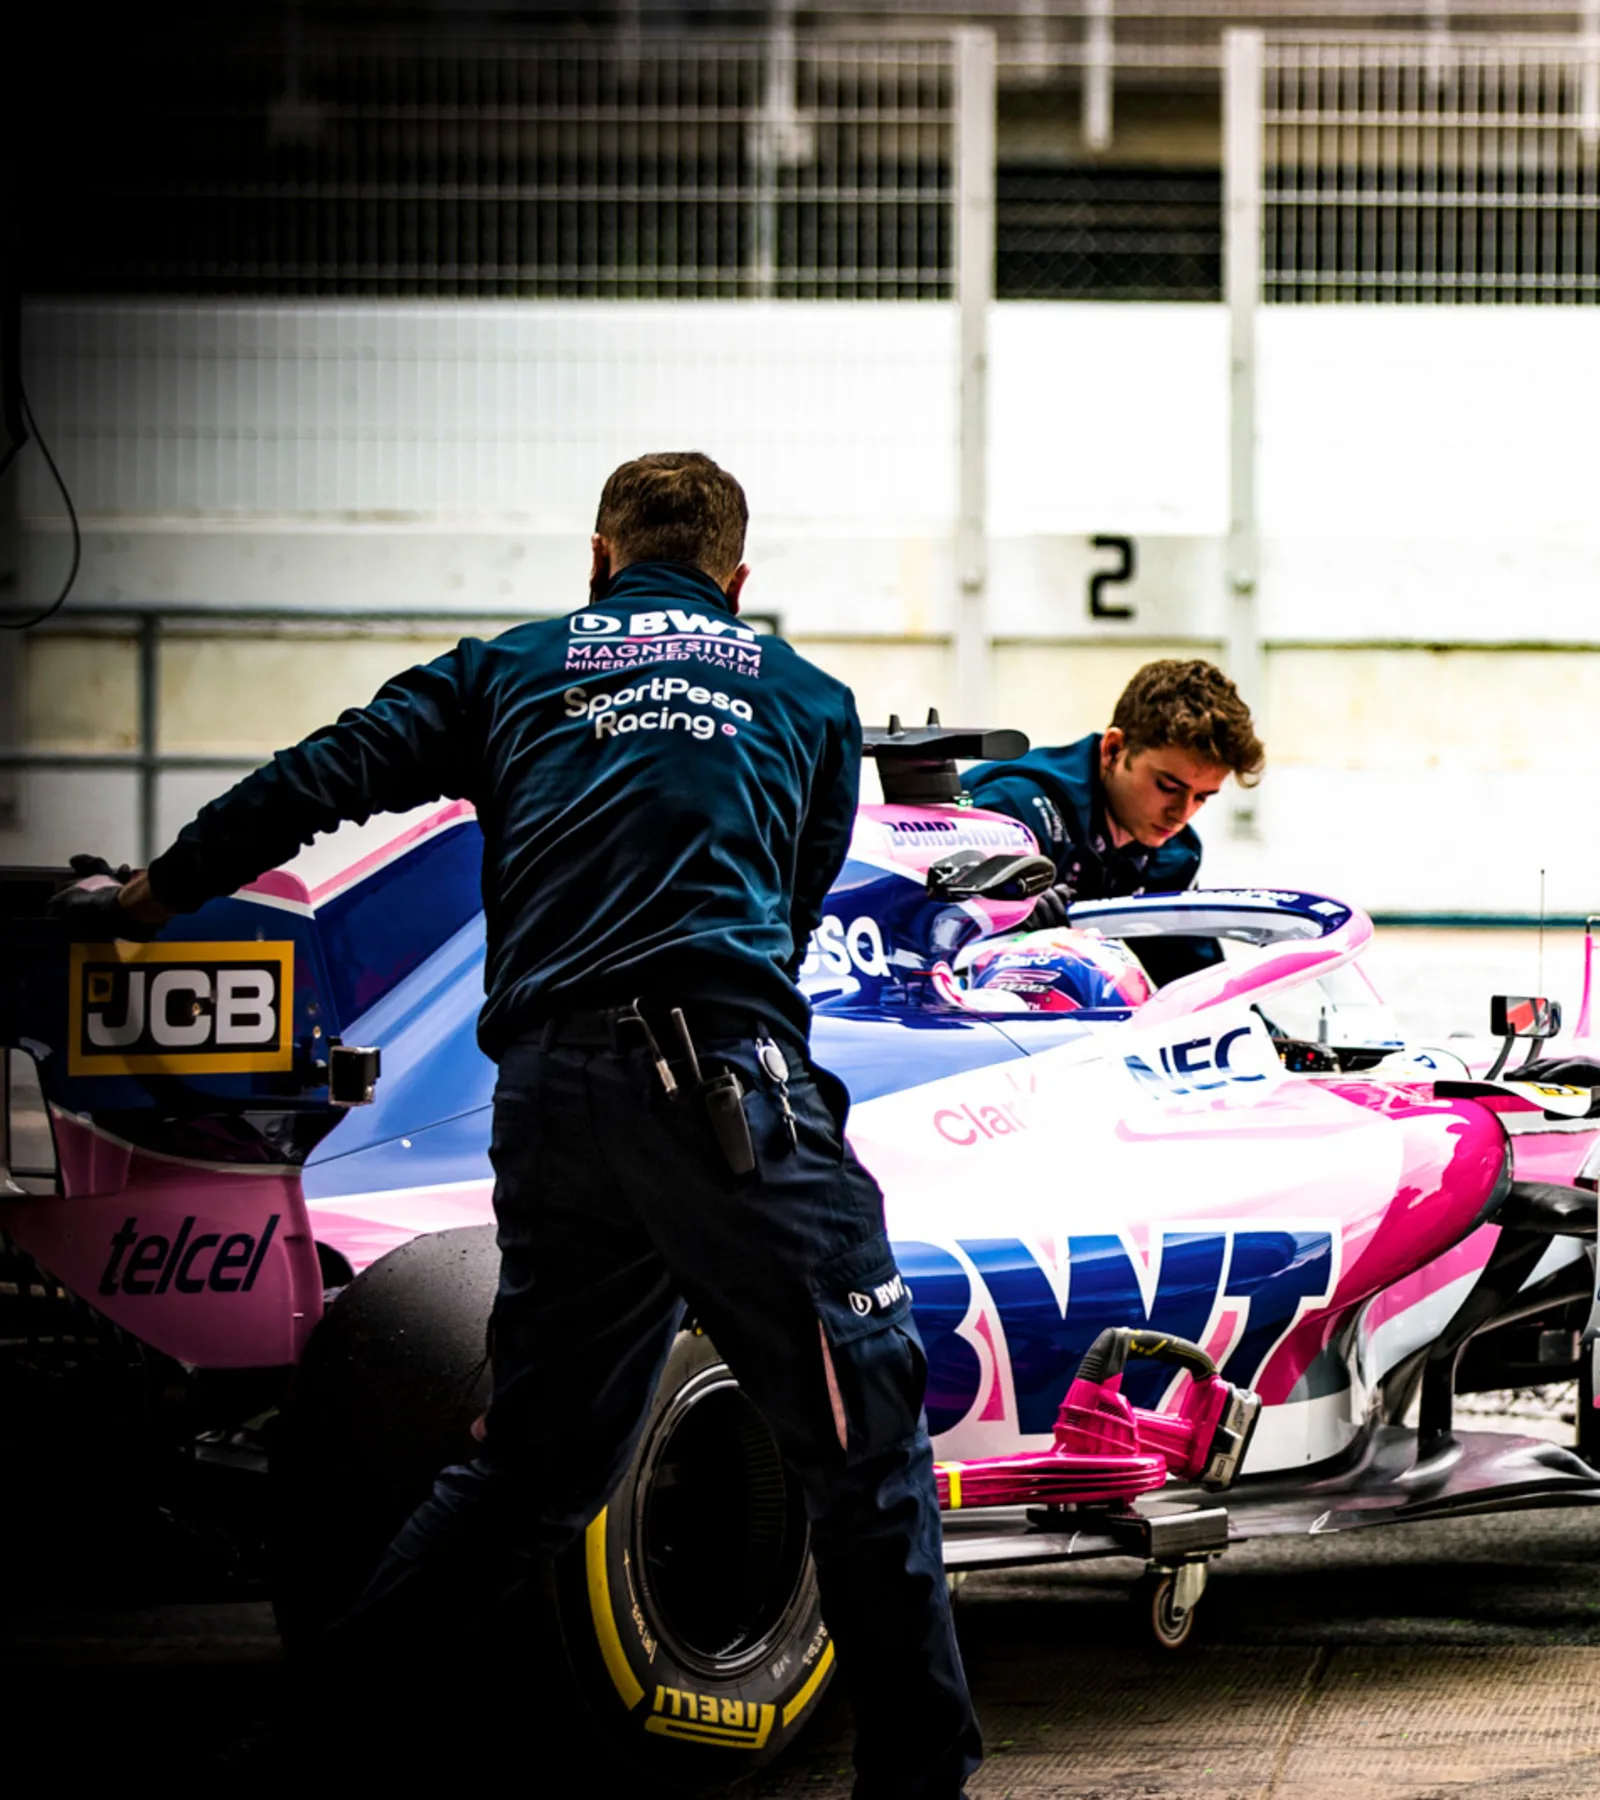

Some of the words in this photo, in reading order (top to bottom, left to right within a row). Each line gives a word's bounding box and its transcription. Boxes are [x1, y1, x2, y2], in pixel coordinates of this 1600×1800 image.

[1088, 535, 1134, 618] 2
[567, 640, 761, 667] MAGNESIUM
[629, 609, 757, 641] BWT
[565, 651, 691, 671] MINERALIZED
[697, 653, 760, 679] WATER
[564, 677, 753, 722] SportPesa
[595, 707, 716, 740] Racing
[87, 969, 276, 1047] JCB
[1123, 1026, 1266, 1100] NEC
[98, 1214, 281, 1297] telcel
[893, 1229, 1334, 1437] BWT
[645, 1684, 777, 1750] PIRELLI
